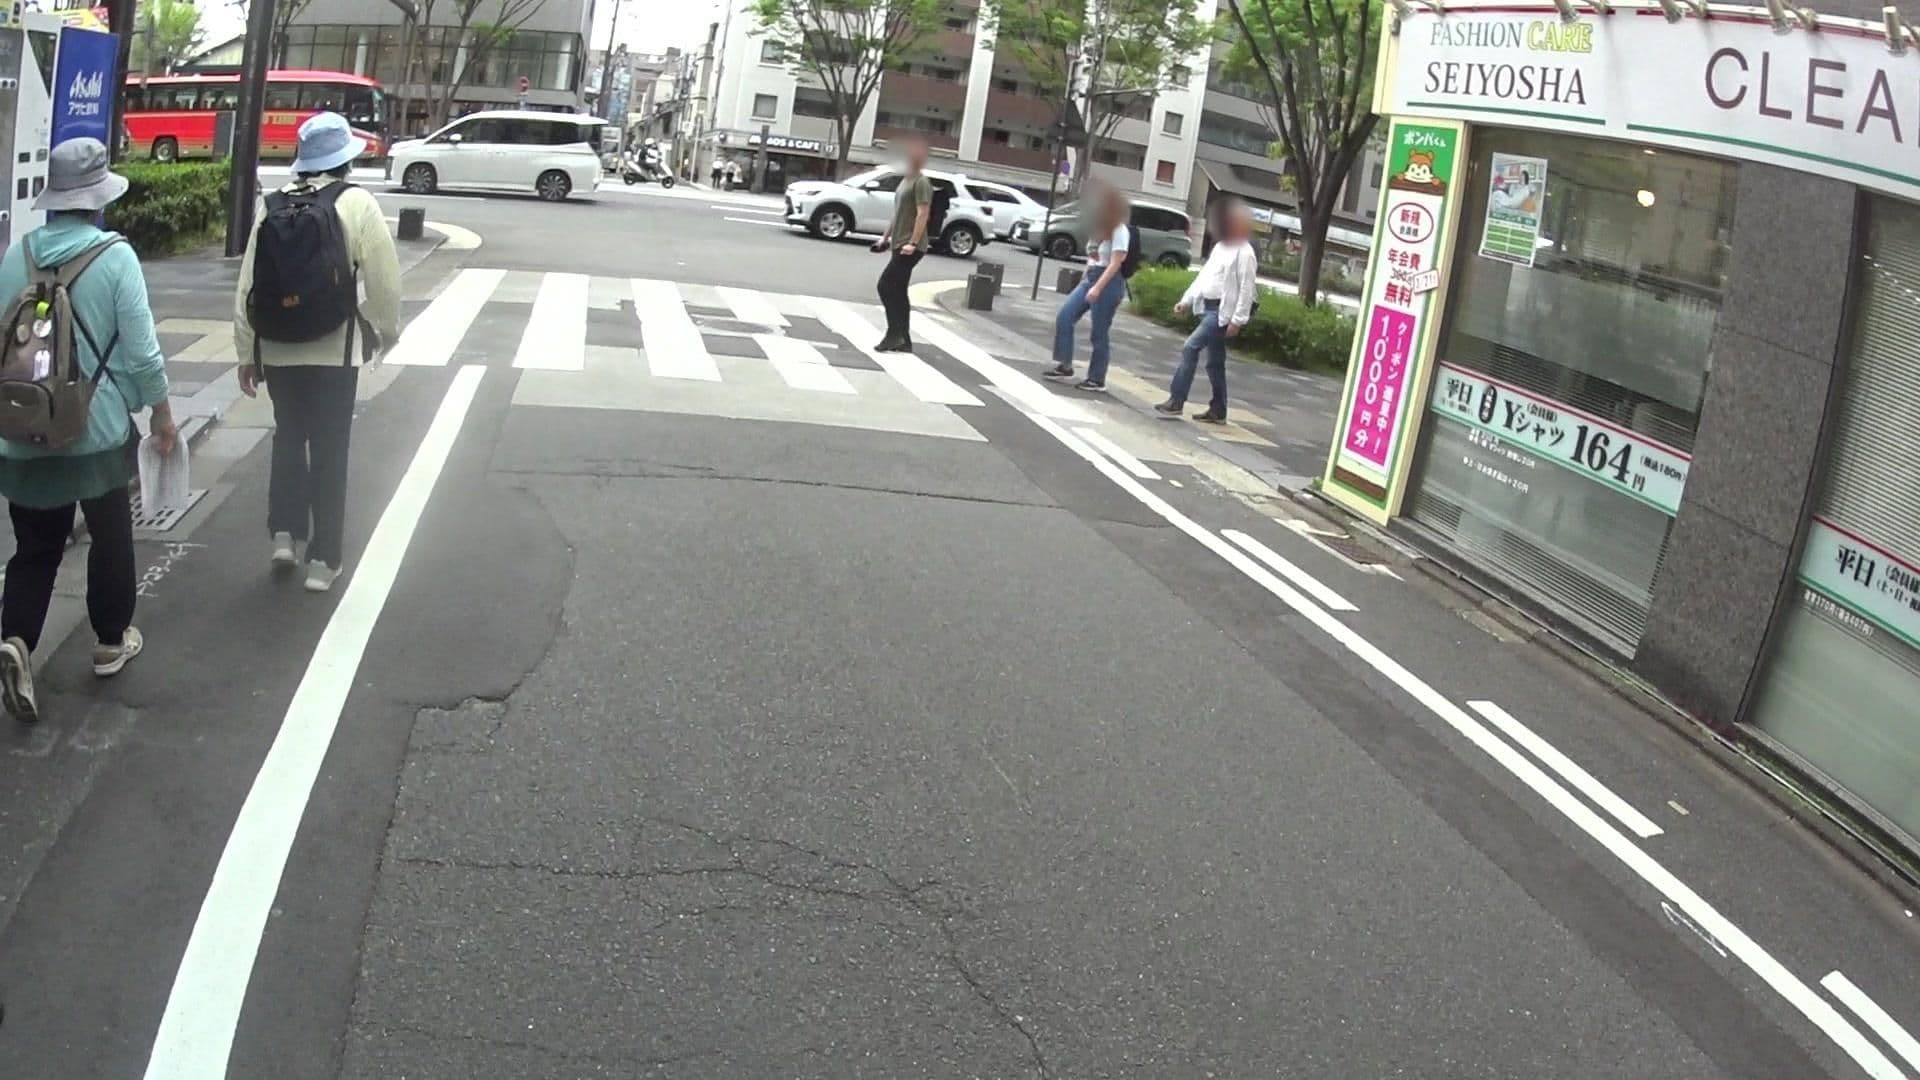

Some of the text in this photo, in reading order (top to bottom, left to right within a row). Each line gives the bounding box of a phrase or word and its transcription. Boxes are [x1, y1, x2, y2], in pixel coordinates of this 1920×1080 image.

[1430, 20, 1594, 54] FASHION CARE
[69, 70, 103, 99] Asahi
[1424, 61, 1587, 105] SEIYOSHA
[1705, 47, 1920, 147] CLEA
[795, 139, 820, 151] CAFE
[1387, 247, 1421, 271] 年会費
[1384, 281, 1413, 308] 無料
[1447, 378, 1473, 405] 平日
[1503, 398, 1565, 447] Yシャツ
[1835, 544, 1875, 588] 平日
